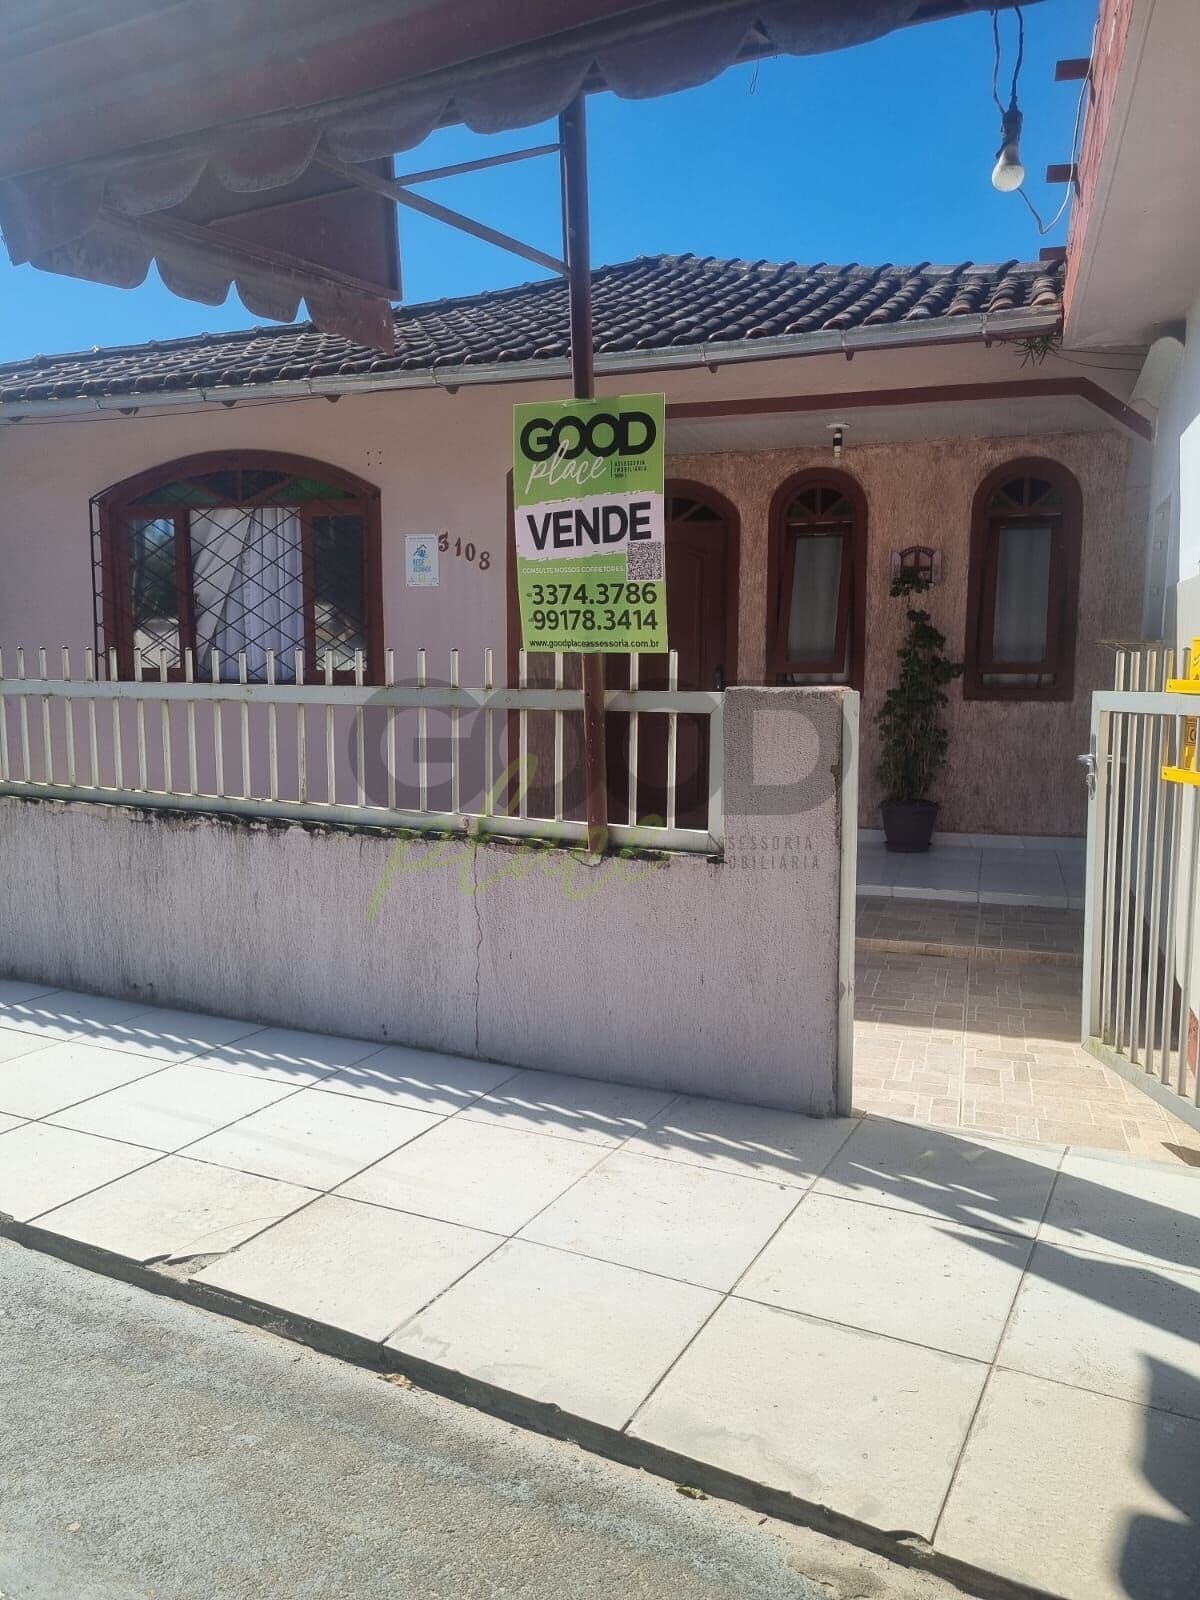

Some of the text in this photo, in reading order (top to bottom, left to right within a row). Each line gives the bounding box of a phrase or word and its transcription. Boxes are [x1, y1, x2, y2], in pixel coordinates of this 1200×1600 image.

[520, 412, 656, 461] GOOD
[525, 439, 607, 495] place
[526, 501, 652, 550] VENDE
[438, 531, 491, 570] 3108
[532, 582, 657, 605] 3374.3786
[533, 609, 658, 631] 99178.3414
[530, 639, 659, 649] www.goodplaceassessoria.com.br
